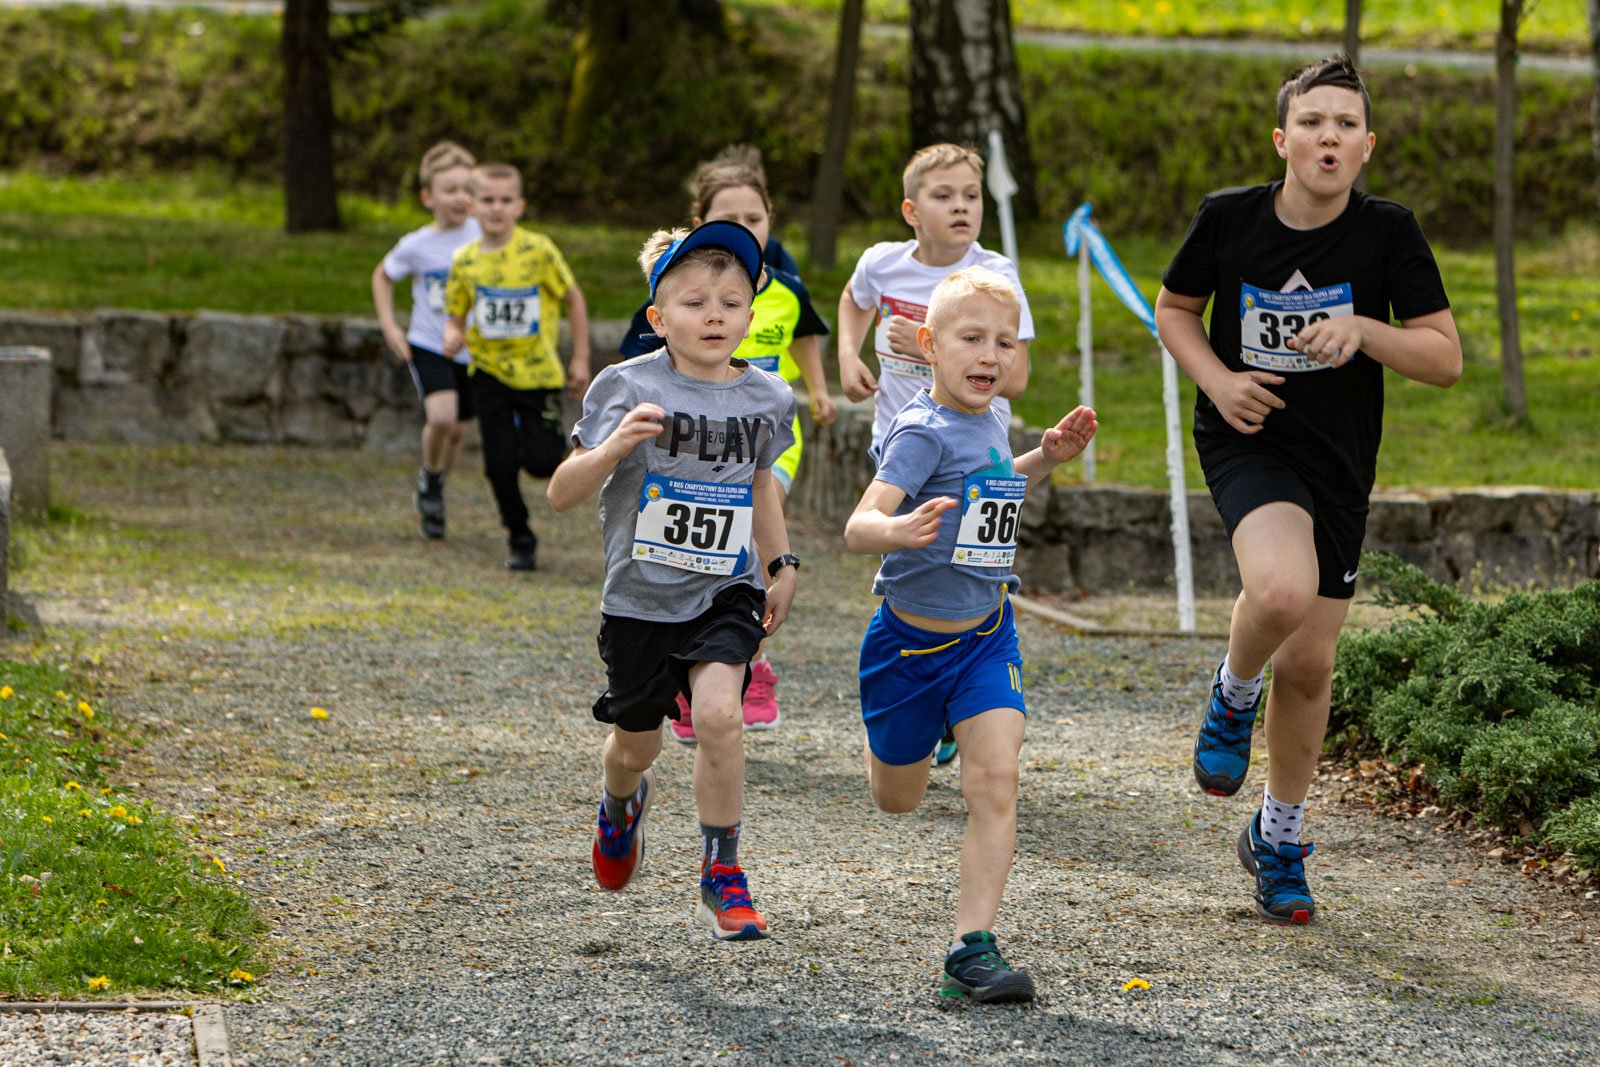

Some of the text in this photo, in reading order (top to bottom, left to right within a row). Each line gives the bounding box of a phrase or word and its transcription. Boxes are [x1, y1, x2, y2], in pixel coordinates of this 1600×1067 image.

[485, 301, 527, 325] 342
[1259, 311, 1331, 351] 33
[669, 411, 761, 464] PLAY
[695, 429, 744, 446] TE/GME
[663, 503, 734, 551] 357
